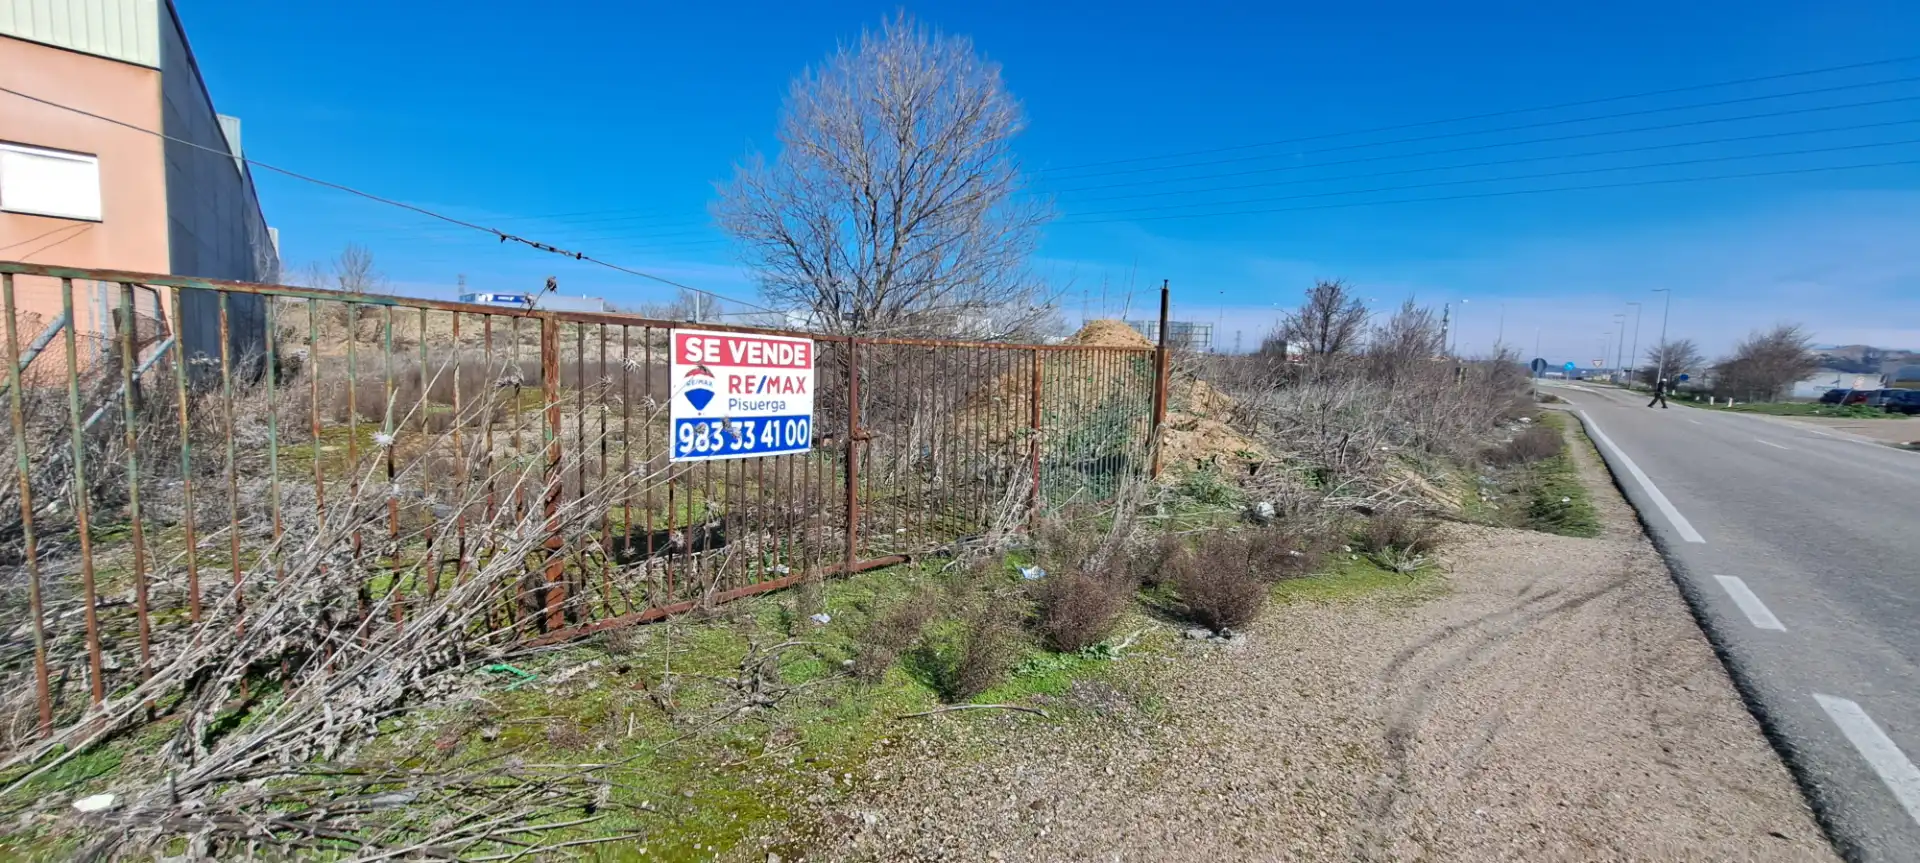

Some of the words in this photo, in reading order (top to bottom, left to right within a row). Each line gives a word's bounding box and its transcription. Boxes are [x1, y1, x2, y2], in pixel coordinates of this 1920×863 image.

[685, 337, 721, 363] SE
[728, 340, 806, 366] VENDE
[729, 375, 807, 394] RE/MAX
[729, 398, 786, 412] Pisuerga
[679, 422, 724, 453] 983
[730, 421, 755, 450] 33
[760, 420, 780, 448] 41
[785, 419, 808, 446] 00
